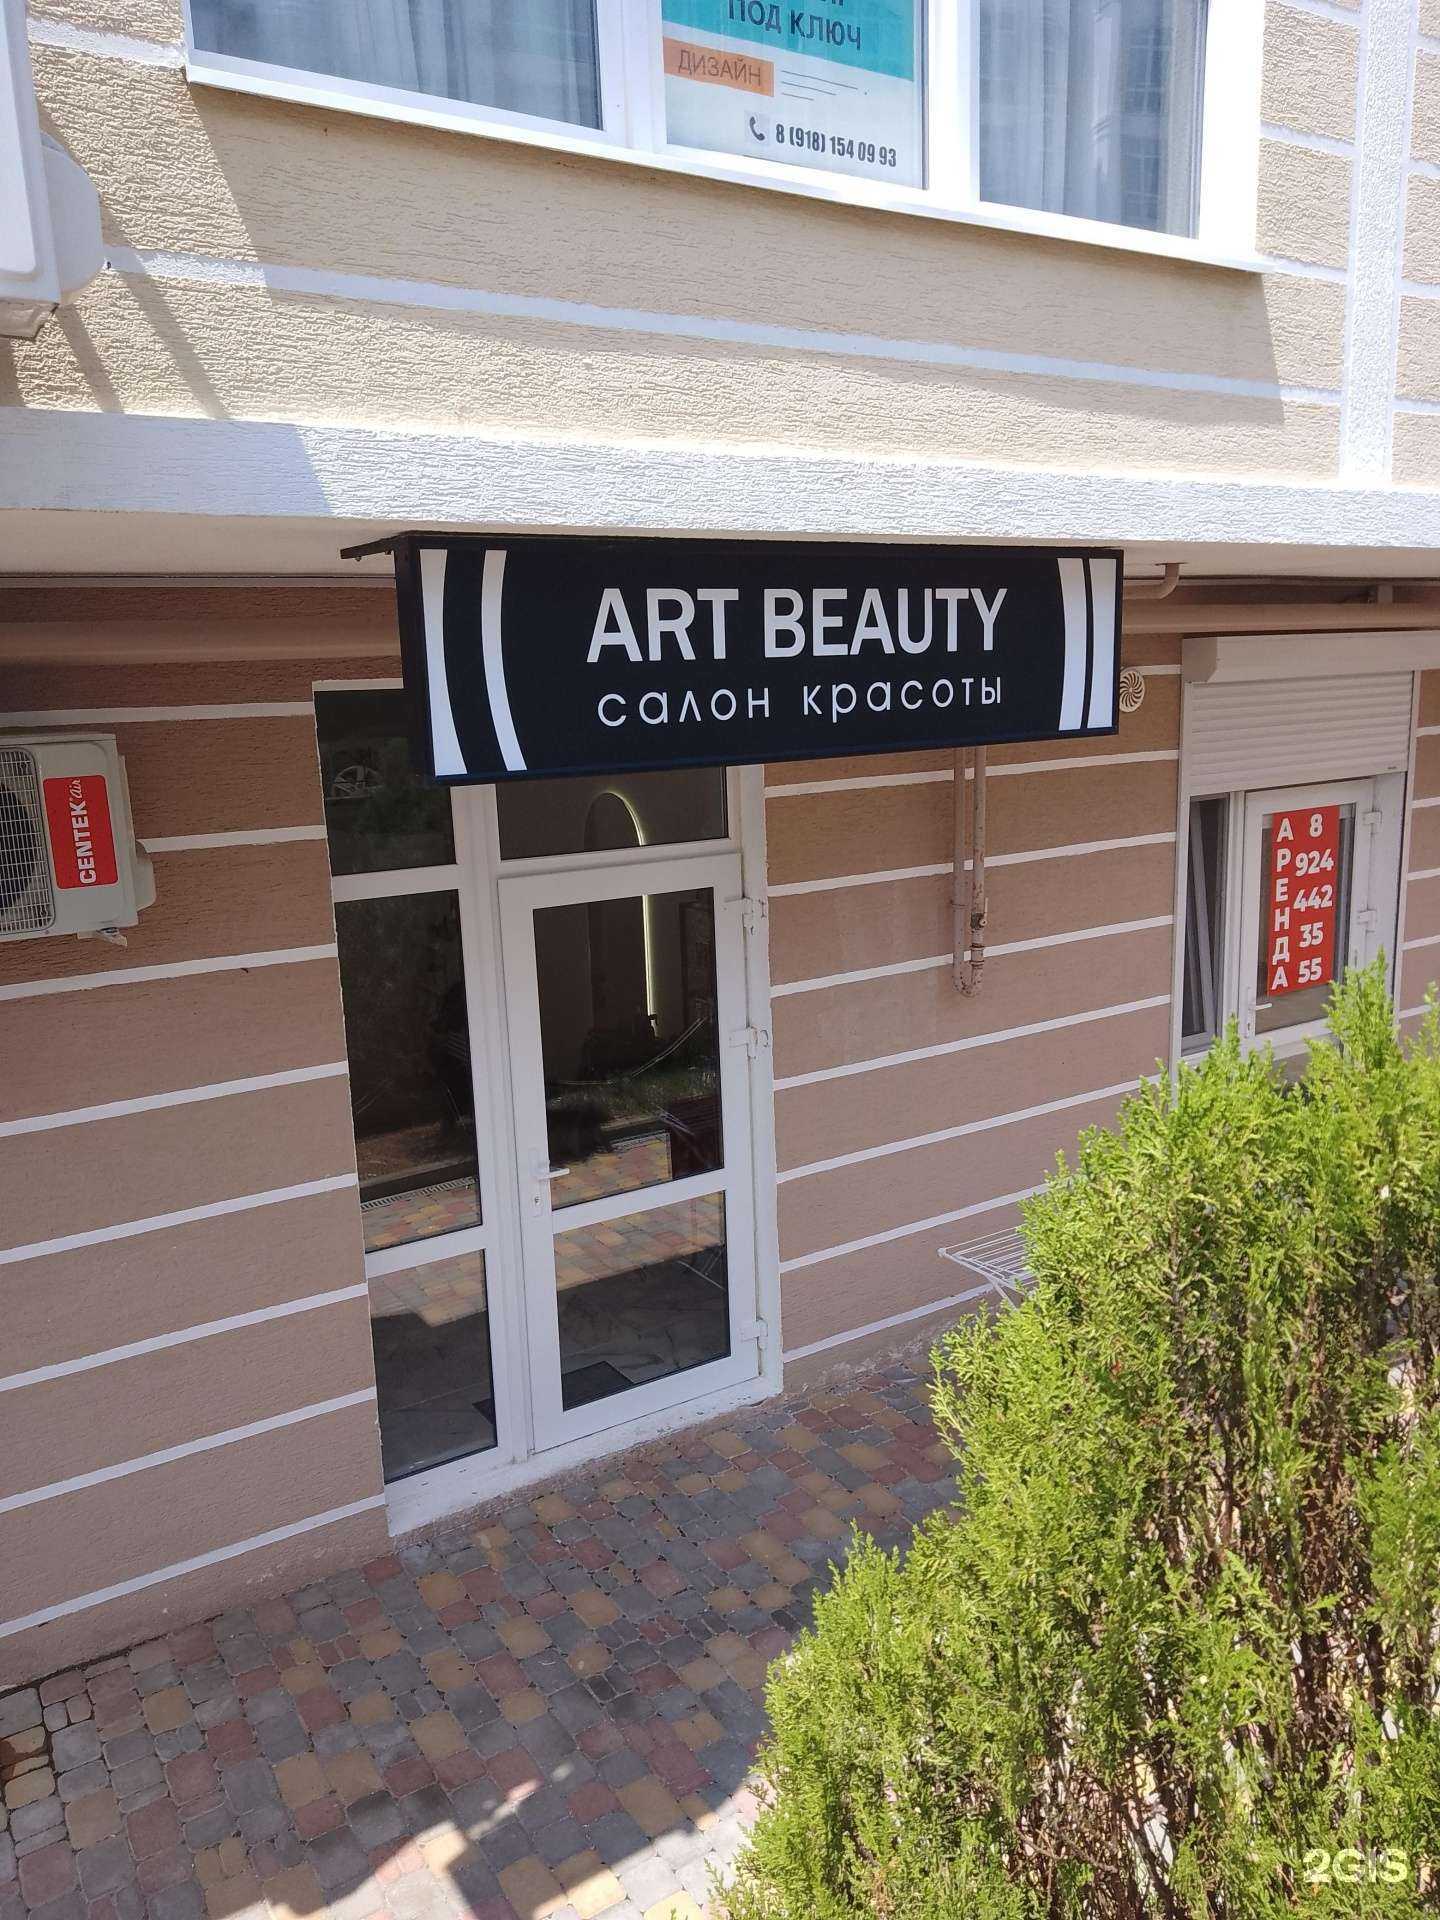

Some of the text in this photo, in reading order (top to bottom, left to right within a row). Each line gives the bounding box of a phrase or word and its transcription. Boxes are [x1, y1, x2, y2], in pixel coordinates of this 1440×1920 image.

[728, 0, 861, 50] ПОД КЛЮЧ
[678, 49, 762, 86] ДИЗАЙН
[776, 123, 897, 167] 8 (918) 154 09 93
[586, 587, 1008, 663] ART BEAUTY
[597, 676, 1001, 727] салон красоты
[68, 800, 97, 884] CENTEK
[1309, 813, 1324, 838] 8
[1295, 848, 1334, 877] 924
[1271, 817, 1294, 990] АРЕНДА
[1293, 884, 1333, 912] 442
[1299, 922, 1324, 948] 35
[1298, 957, 1322, 984] 55
